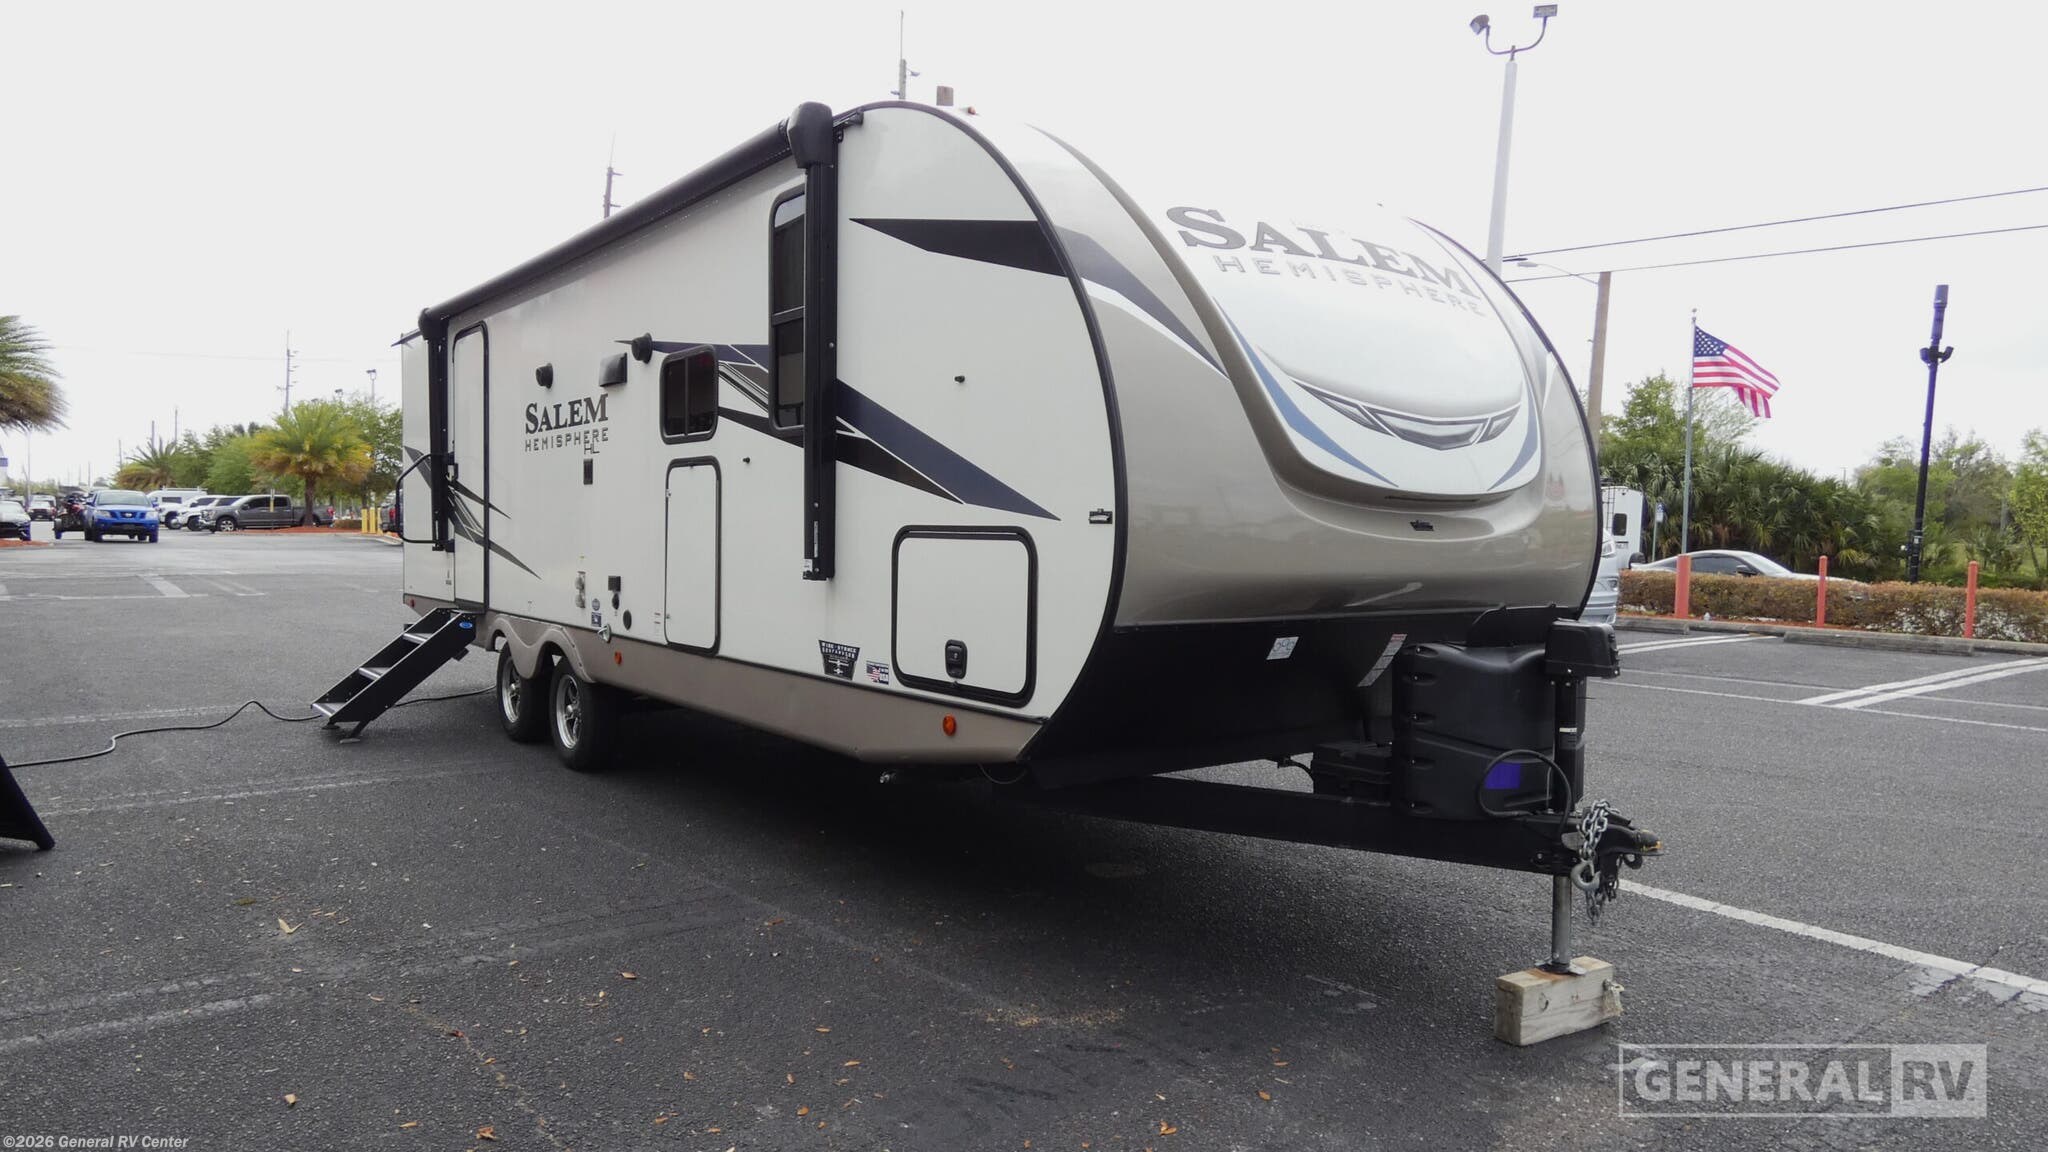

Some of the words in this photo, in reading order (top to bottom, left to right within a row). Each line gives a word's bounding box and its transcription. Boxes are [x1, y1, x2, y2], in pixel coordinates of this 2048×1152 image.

[1166, 206, 1481, 300] SALEM
[1212, 255, 1487, 317] HEMISPHERE
[525, 393, 608, 434] SALEM
[525, 427, 608, 452] HEMISPHERE
[583, 443, 600, 455] HL
